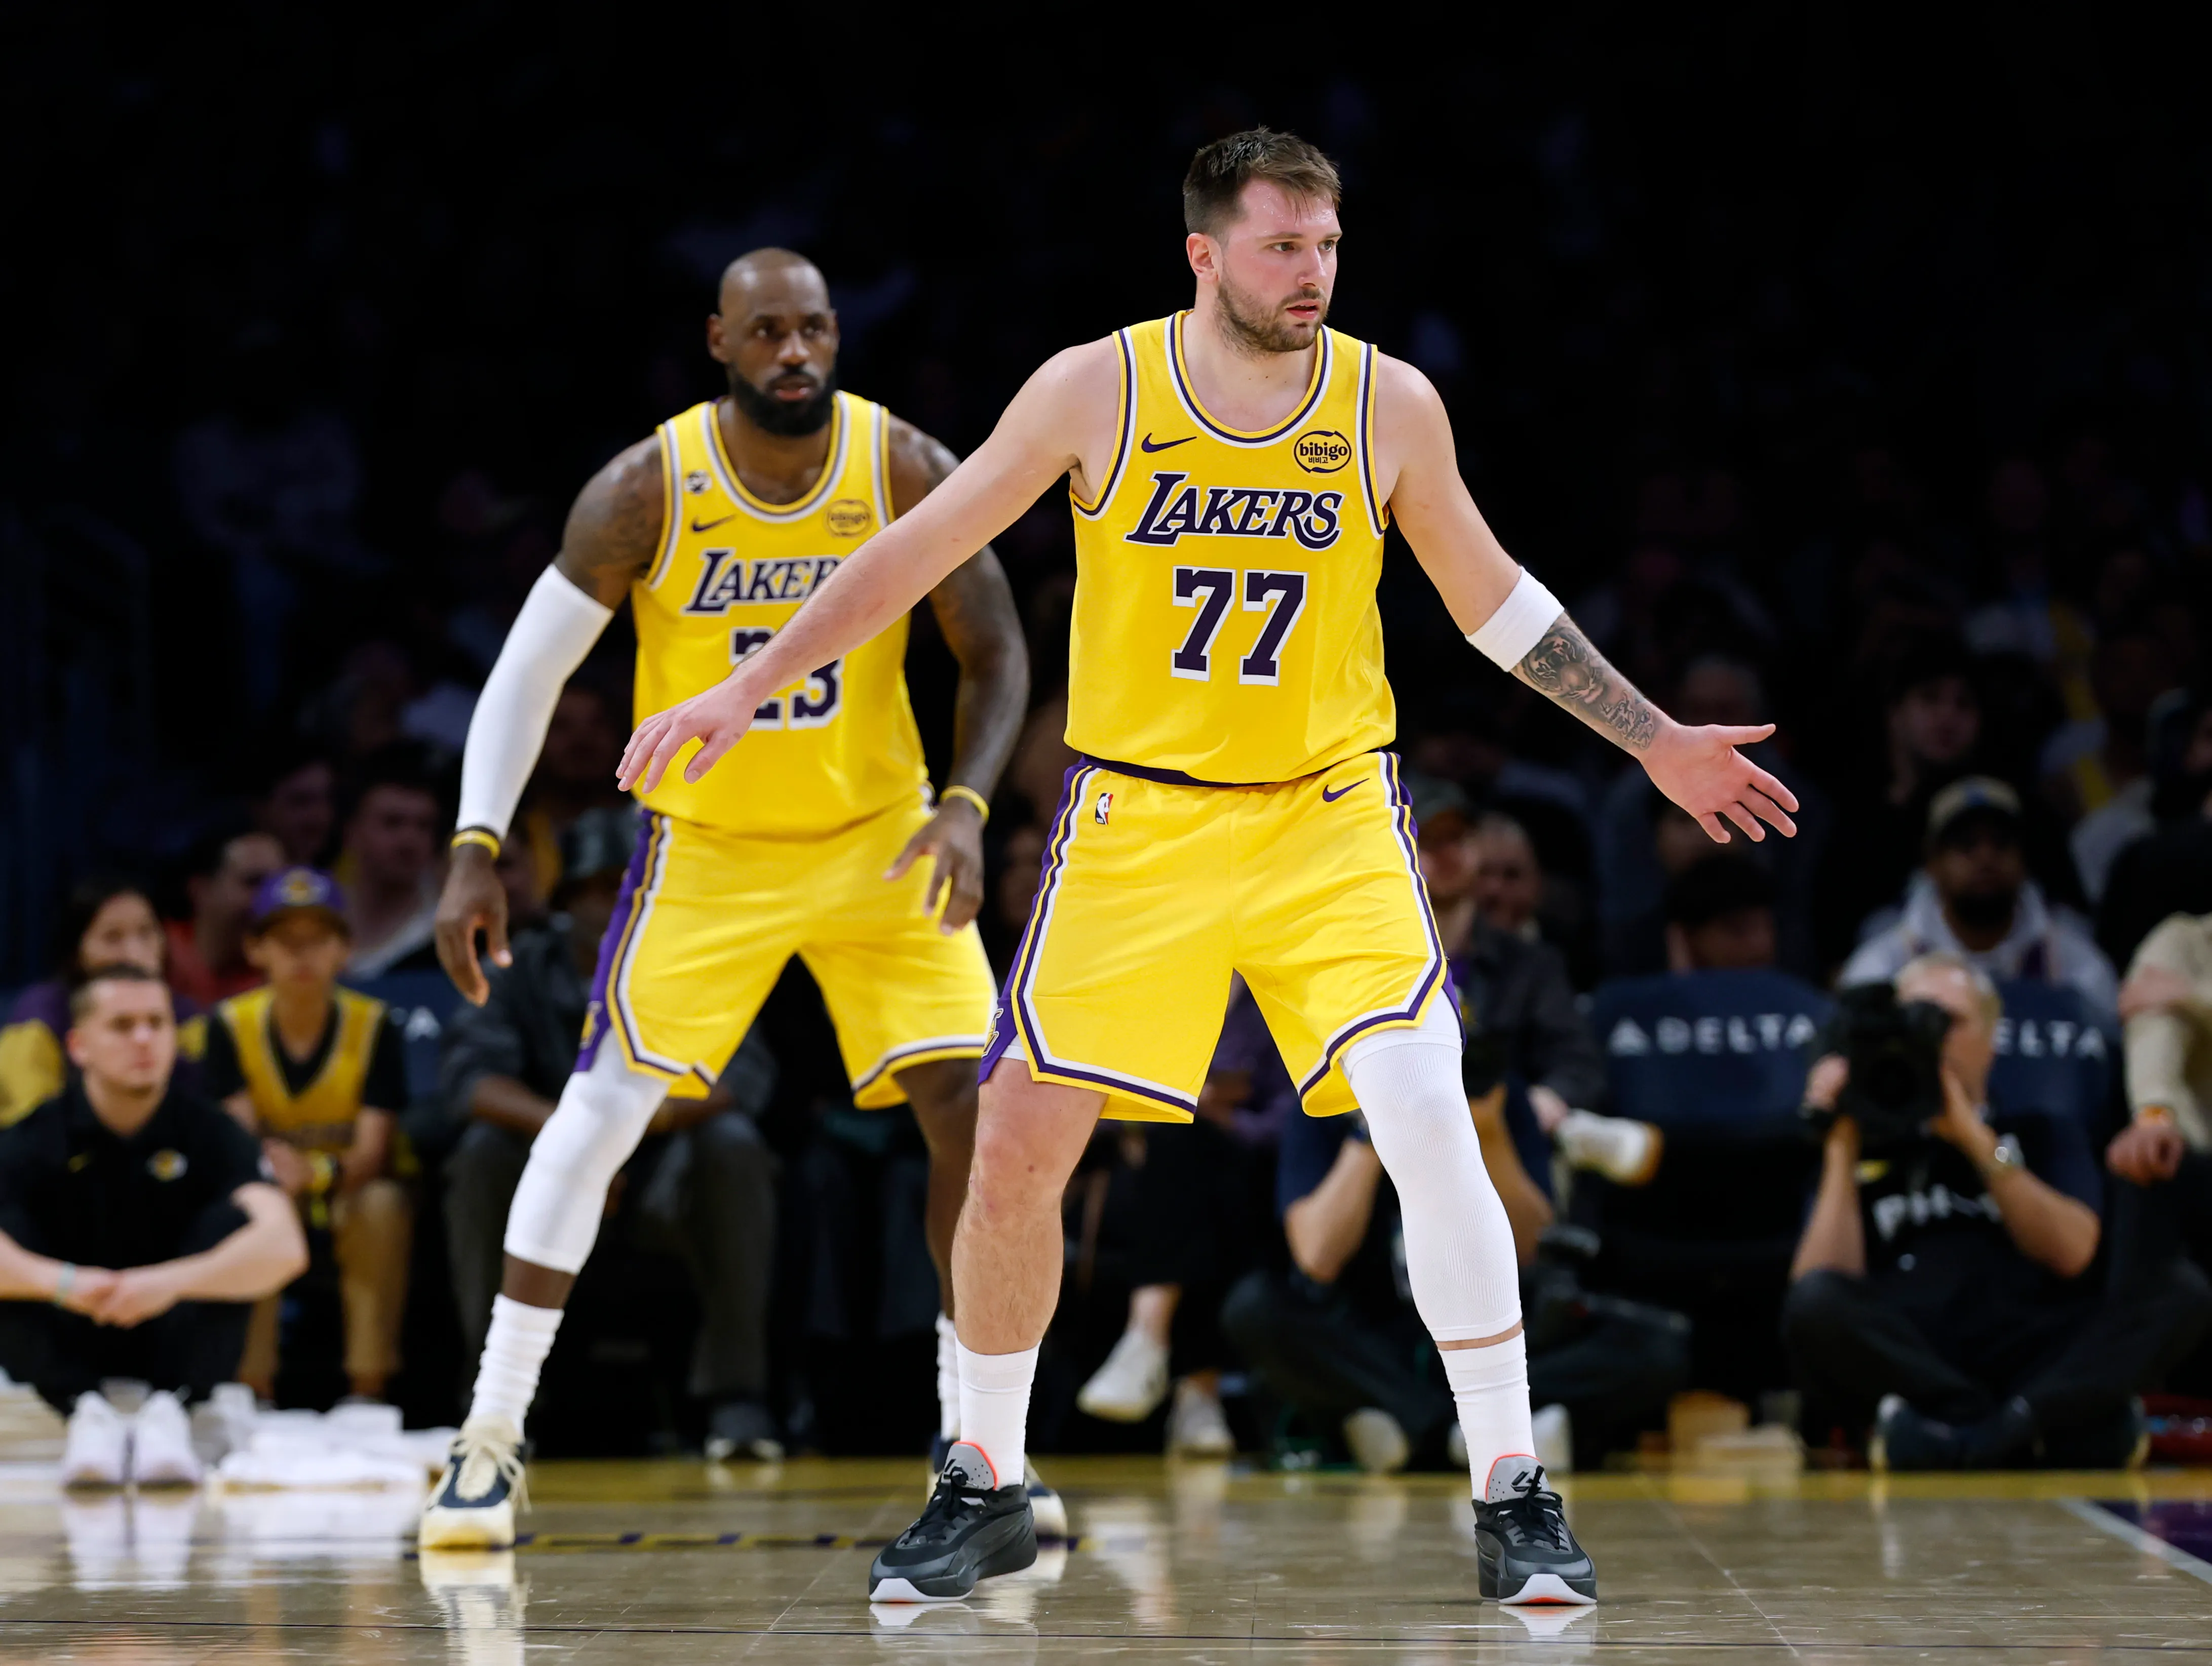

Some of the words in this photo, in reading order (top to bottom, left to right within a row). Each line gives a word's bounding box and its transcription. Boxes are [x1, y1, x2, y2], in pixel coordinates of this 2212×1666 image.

[1299, 442, 1348, 461] bibigo
[1123, 470, 1346, 552] LAKERS
[679, 547, 845, 616] LAKER
[1171, 565, 1308, 687] 77
[1654, 1013, 1818, 1056] DELTA
[1991, 1017, 2109, 1063] ELTA
